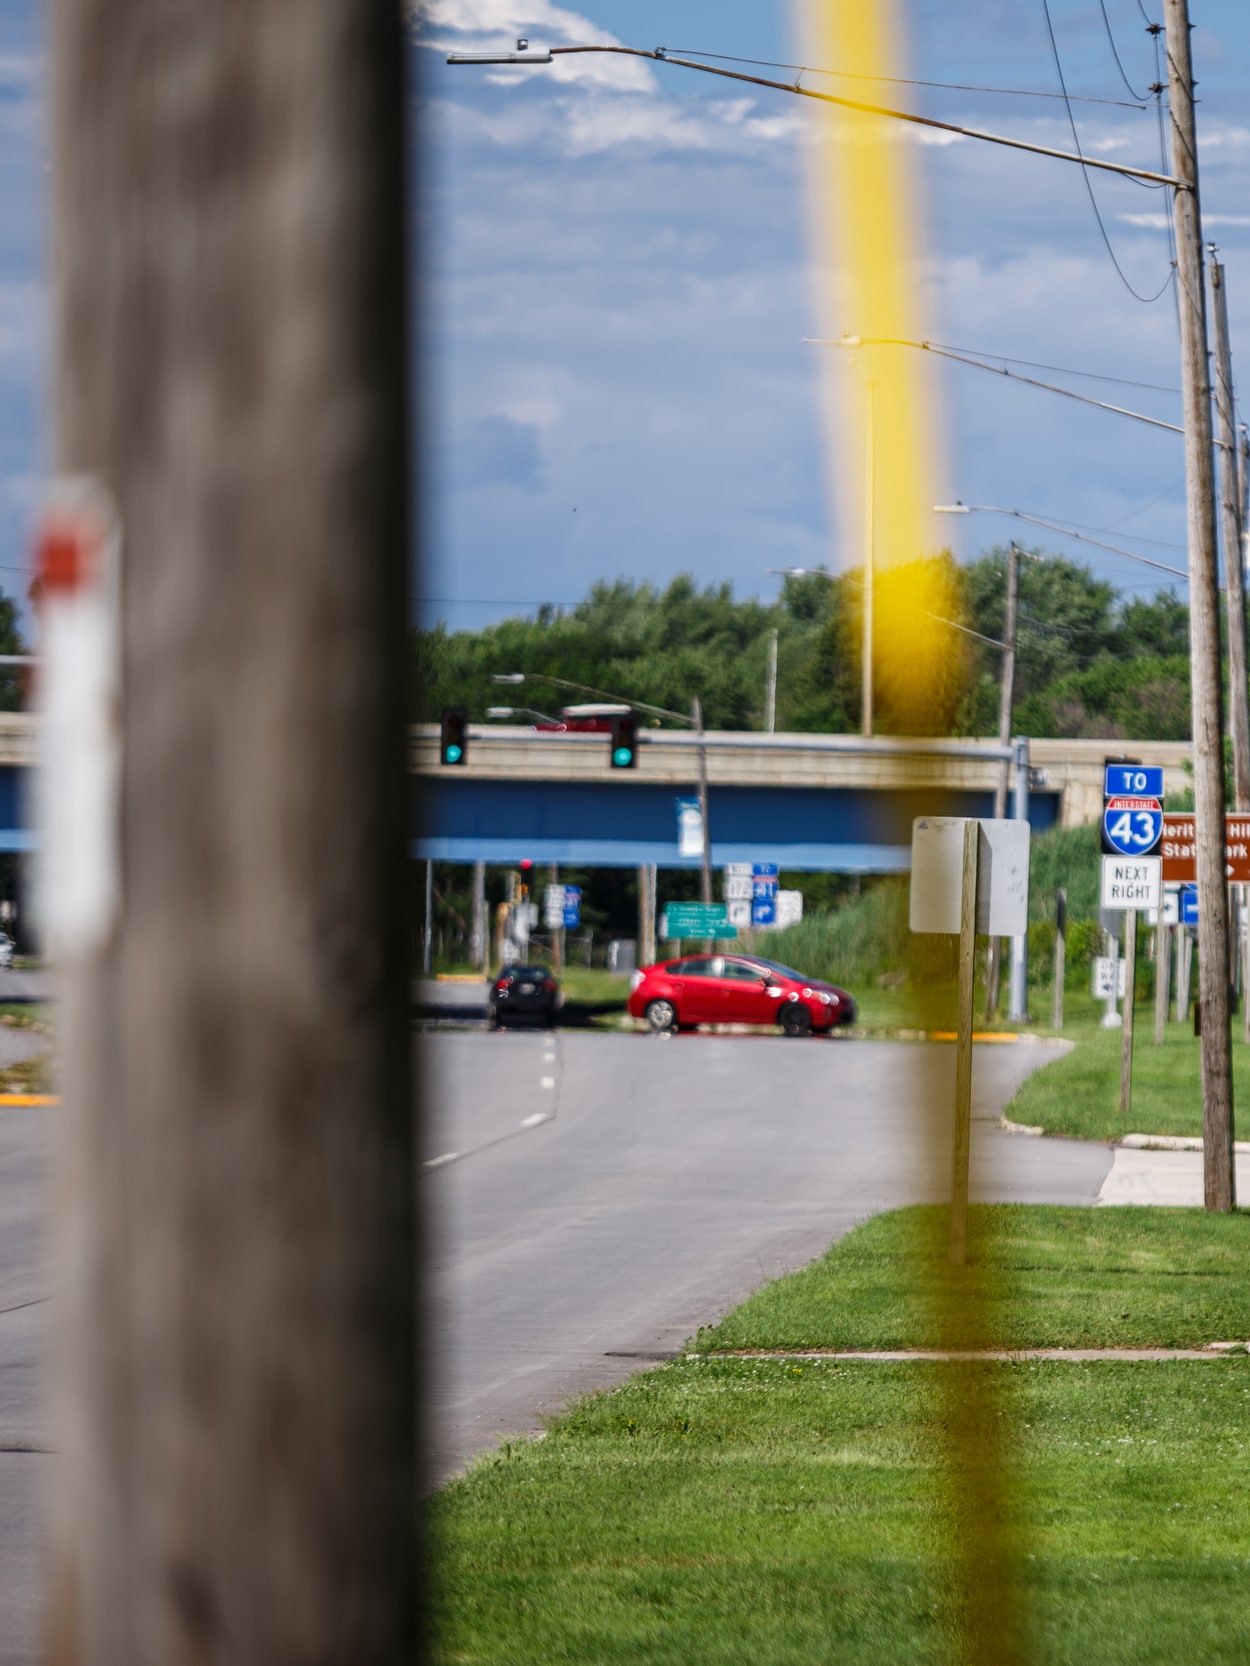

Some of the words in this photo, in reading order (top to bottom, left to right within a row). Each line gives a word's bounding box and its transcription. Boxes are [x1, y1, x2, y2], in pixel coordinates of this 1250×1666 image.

[1123, 771, 1147, 790] TO
[1114, 800, 1155, 809] INTERSTATE
[1110, 811, 1155, 845] 43
[1164, 843, 1197, 857] Stat
[1225, 843, 1248, 857] ark
[1115, 866, 1149, 880] NEXT
[1112, 884, 1151, 899] RIGHT
